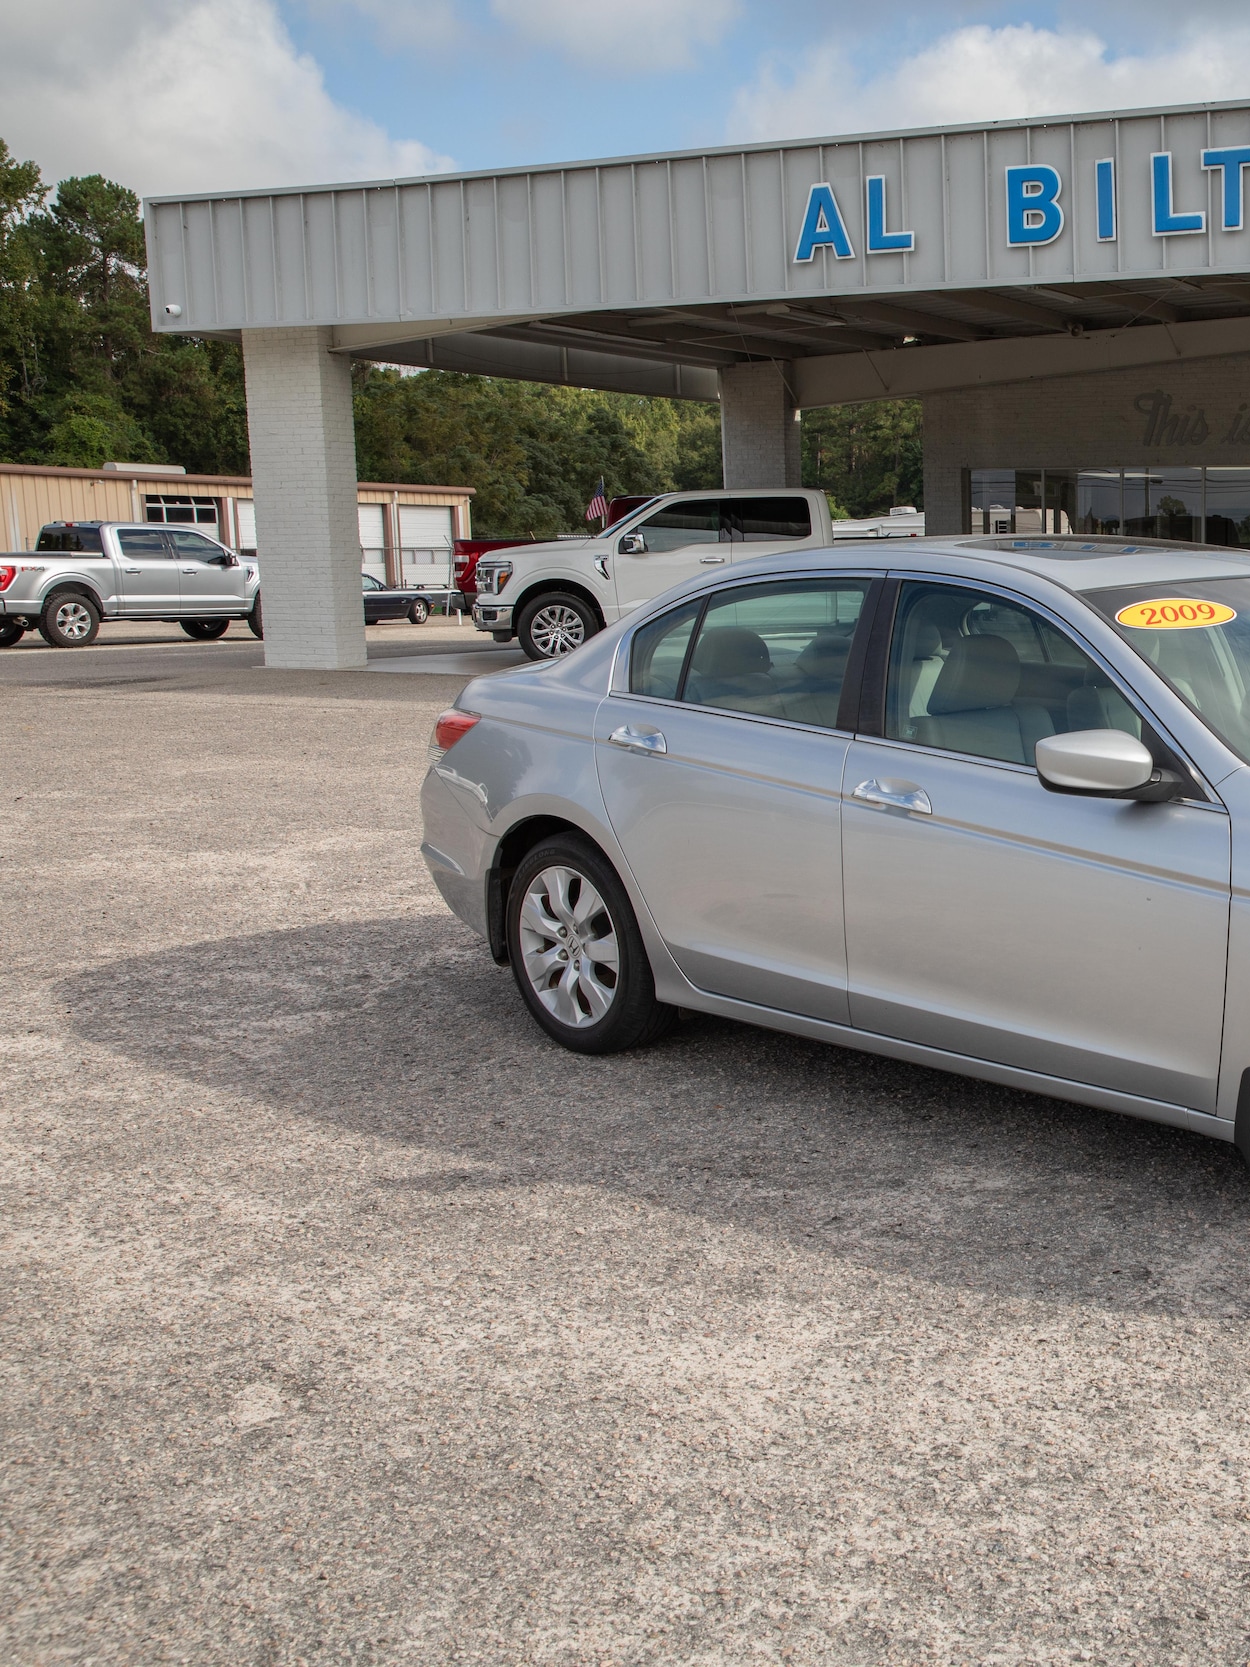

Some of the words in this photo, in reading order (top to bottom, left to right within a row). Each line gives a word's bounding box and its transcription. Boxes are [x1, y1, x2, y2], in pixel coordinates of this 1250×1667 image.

[793, 175, 915, 263] AL
[1134, 389, 1208, 447] This
[1140, 604, 1216, 625] 2009
